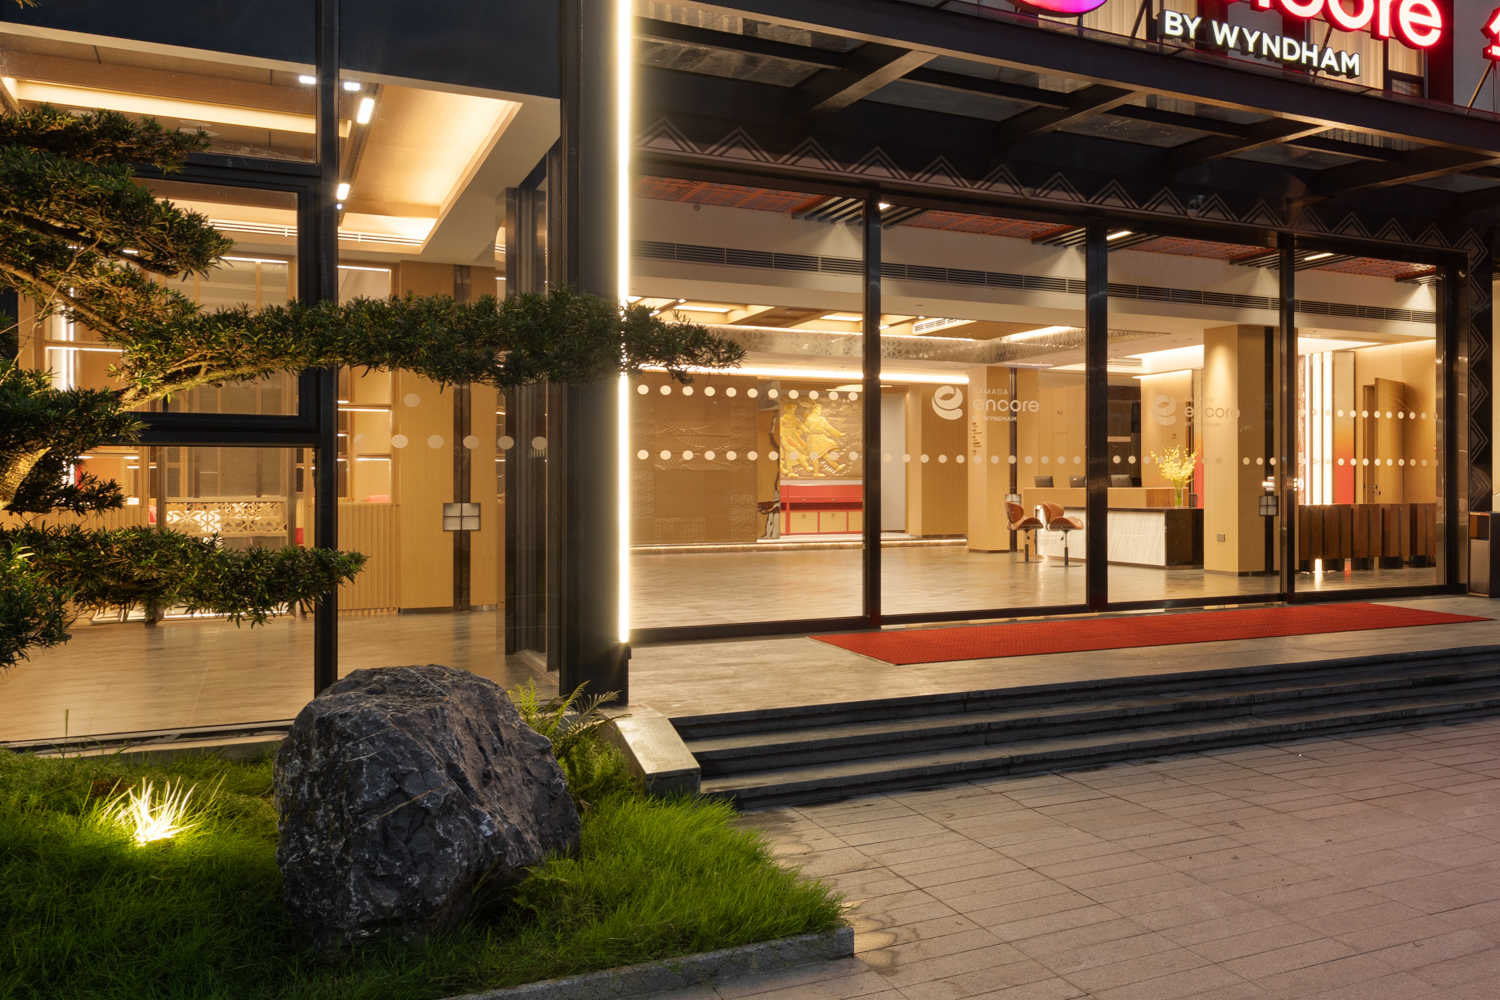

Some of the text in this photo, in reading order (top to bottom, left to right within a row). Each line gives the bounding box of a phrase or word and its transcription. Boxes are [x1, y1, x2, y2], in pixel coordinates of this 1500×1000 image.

[1164, 10, 1360, 76] BY WYNDHAM
[972, 399, 1039, 412] encore
